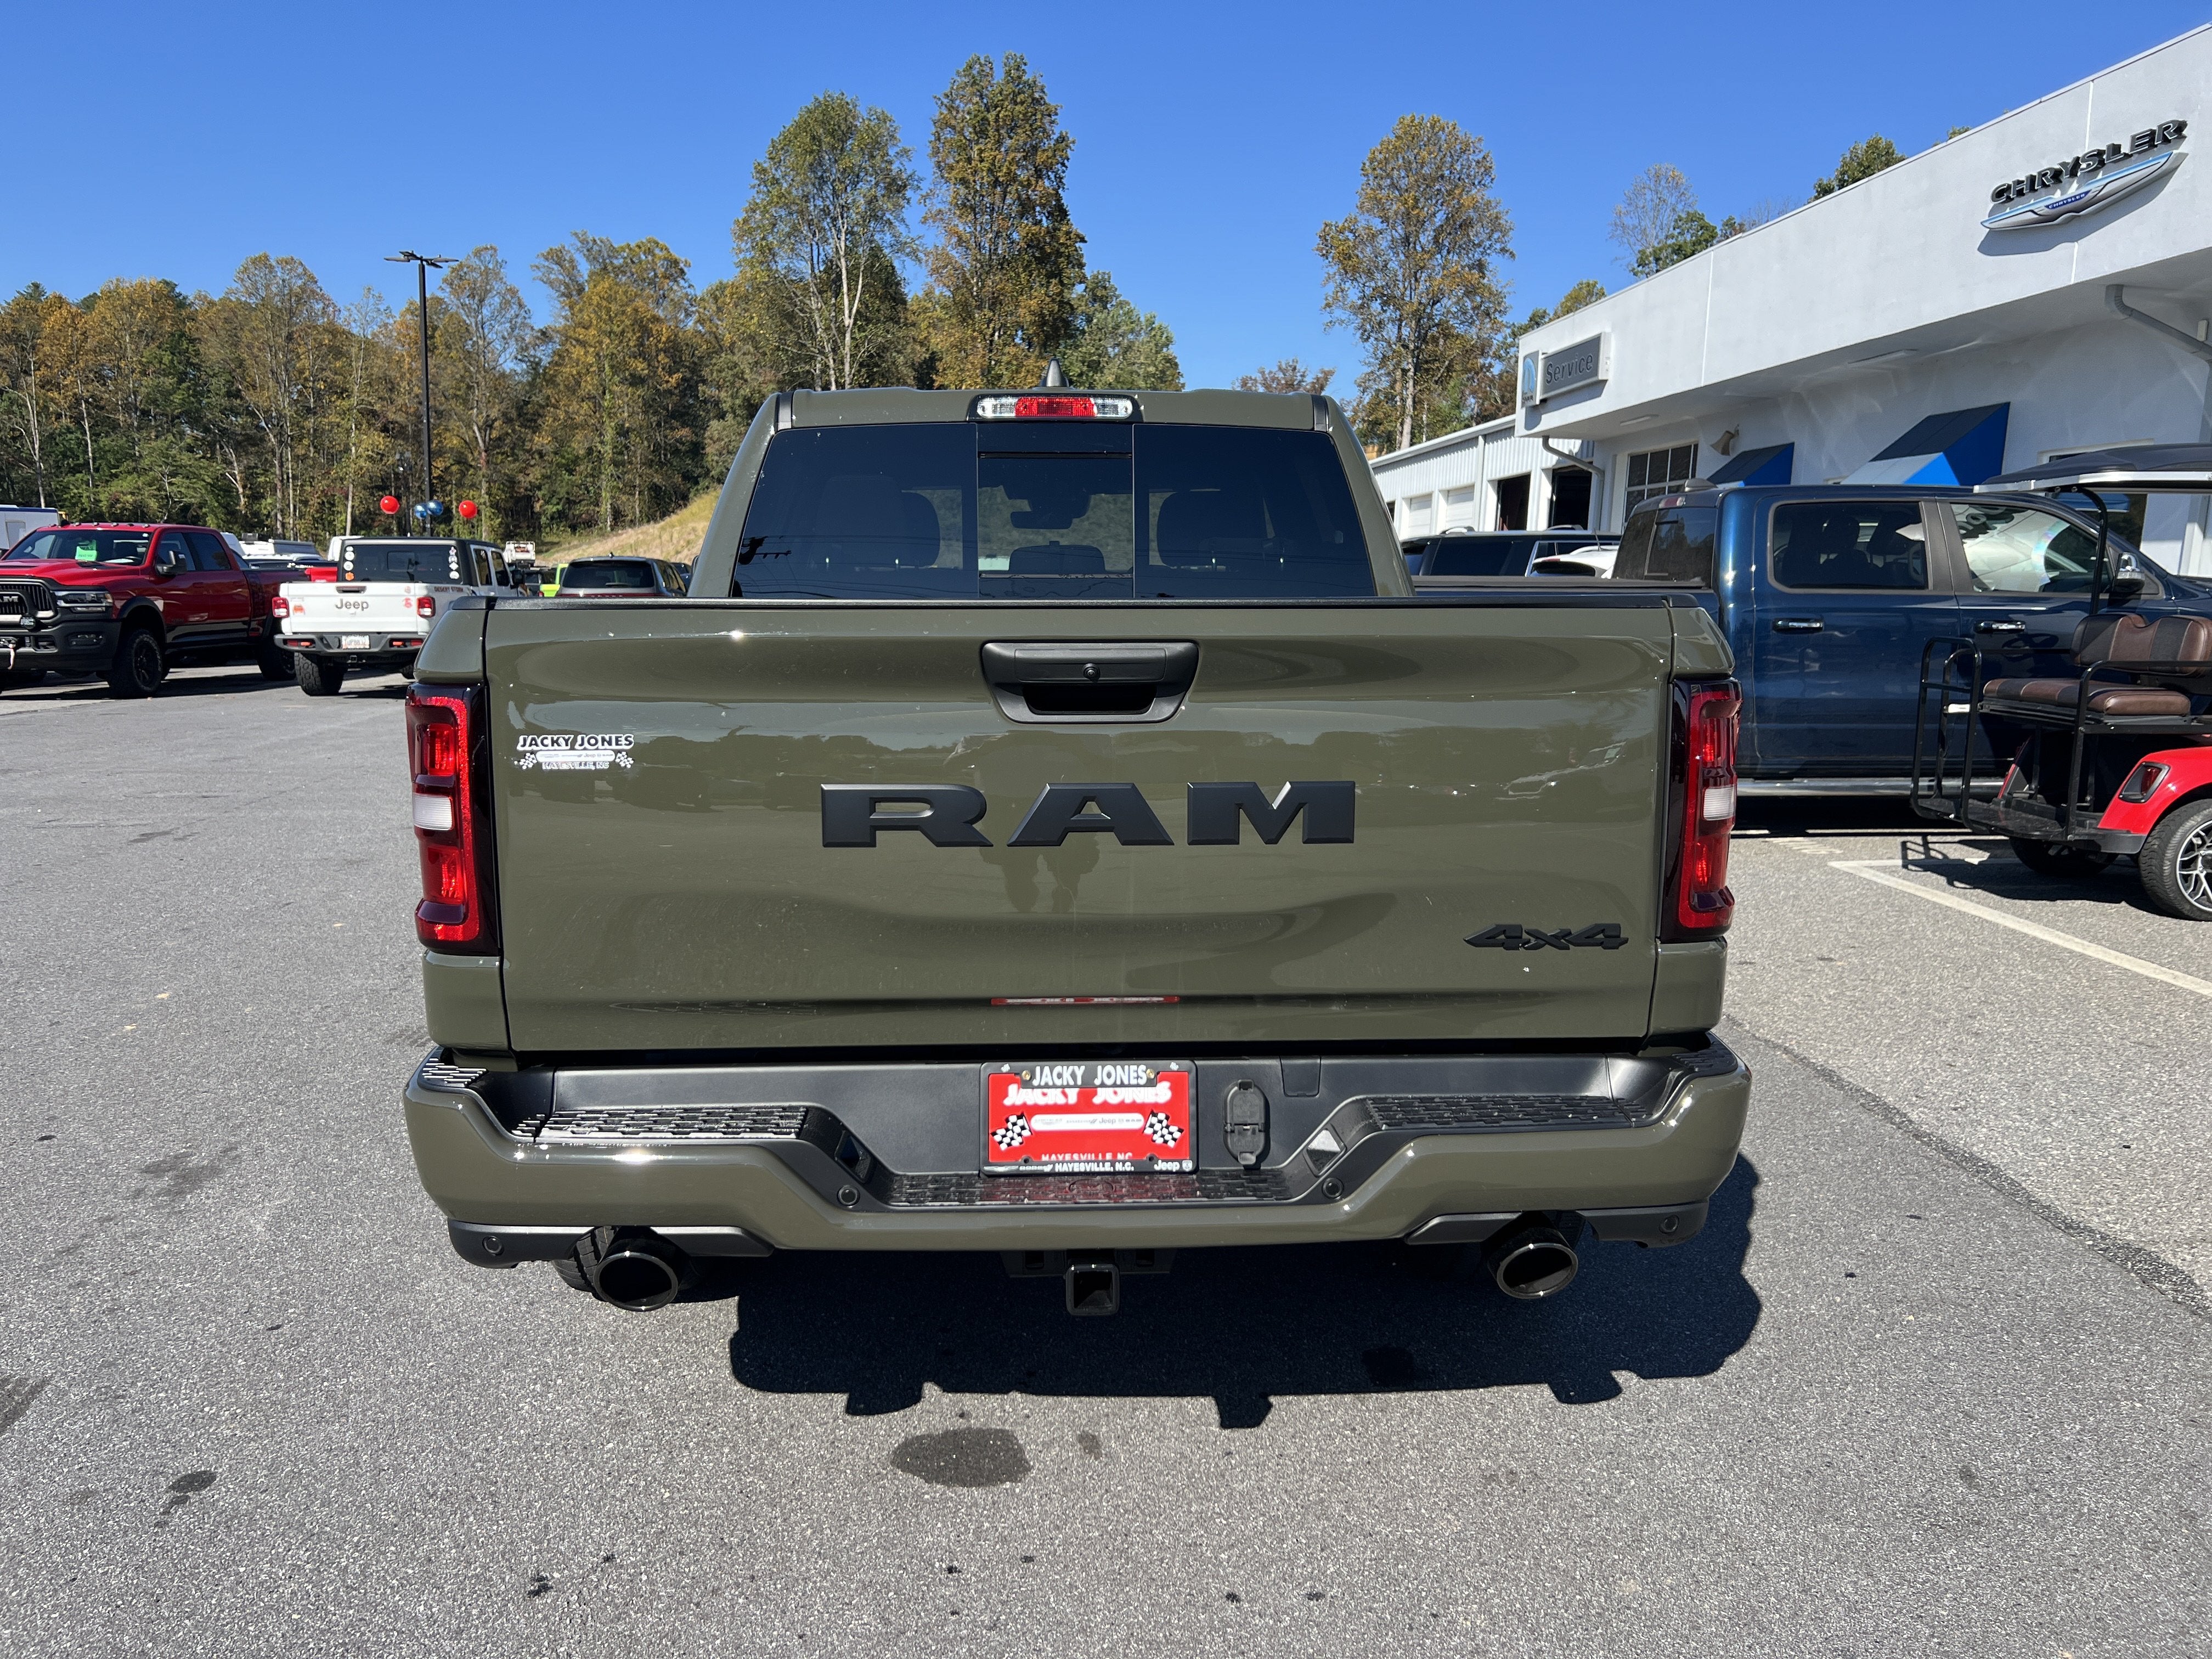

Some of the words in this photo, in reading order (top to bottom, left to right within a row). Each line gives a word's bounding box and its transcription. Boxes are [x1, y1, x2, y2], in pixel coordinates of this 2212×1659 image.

[1990, 119, 2188, 204] CHRYSLER
[1545, 353, 1593, 385] Service
[335, 598, 369, 611] Jeep
[517, 735, 574, 750] JACKY
[575, 734, 634, 750] JONES
[821, 781, 1356, 848] RAM
[1032, 1065, 1086, 1086] JACKY
[1094, 1064, 1147, 1086] JONES
[1003, 1083, 1080, 1106] JACKY
[1092, 1081, 1172, 1104] JONES
[1055, 1162, 1114, 1172] HAYESVILLE,
[1115, 1161, 1135, 1171] N.C.
[1154, 1160, 1180, 1172] Jeep
